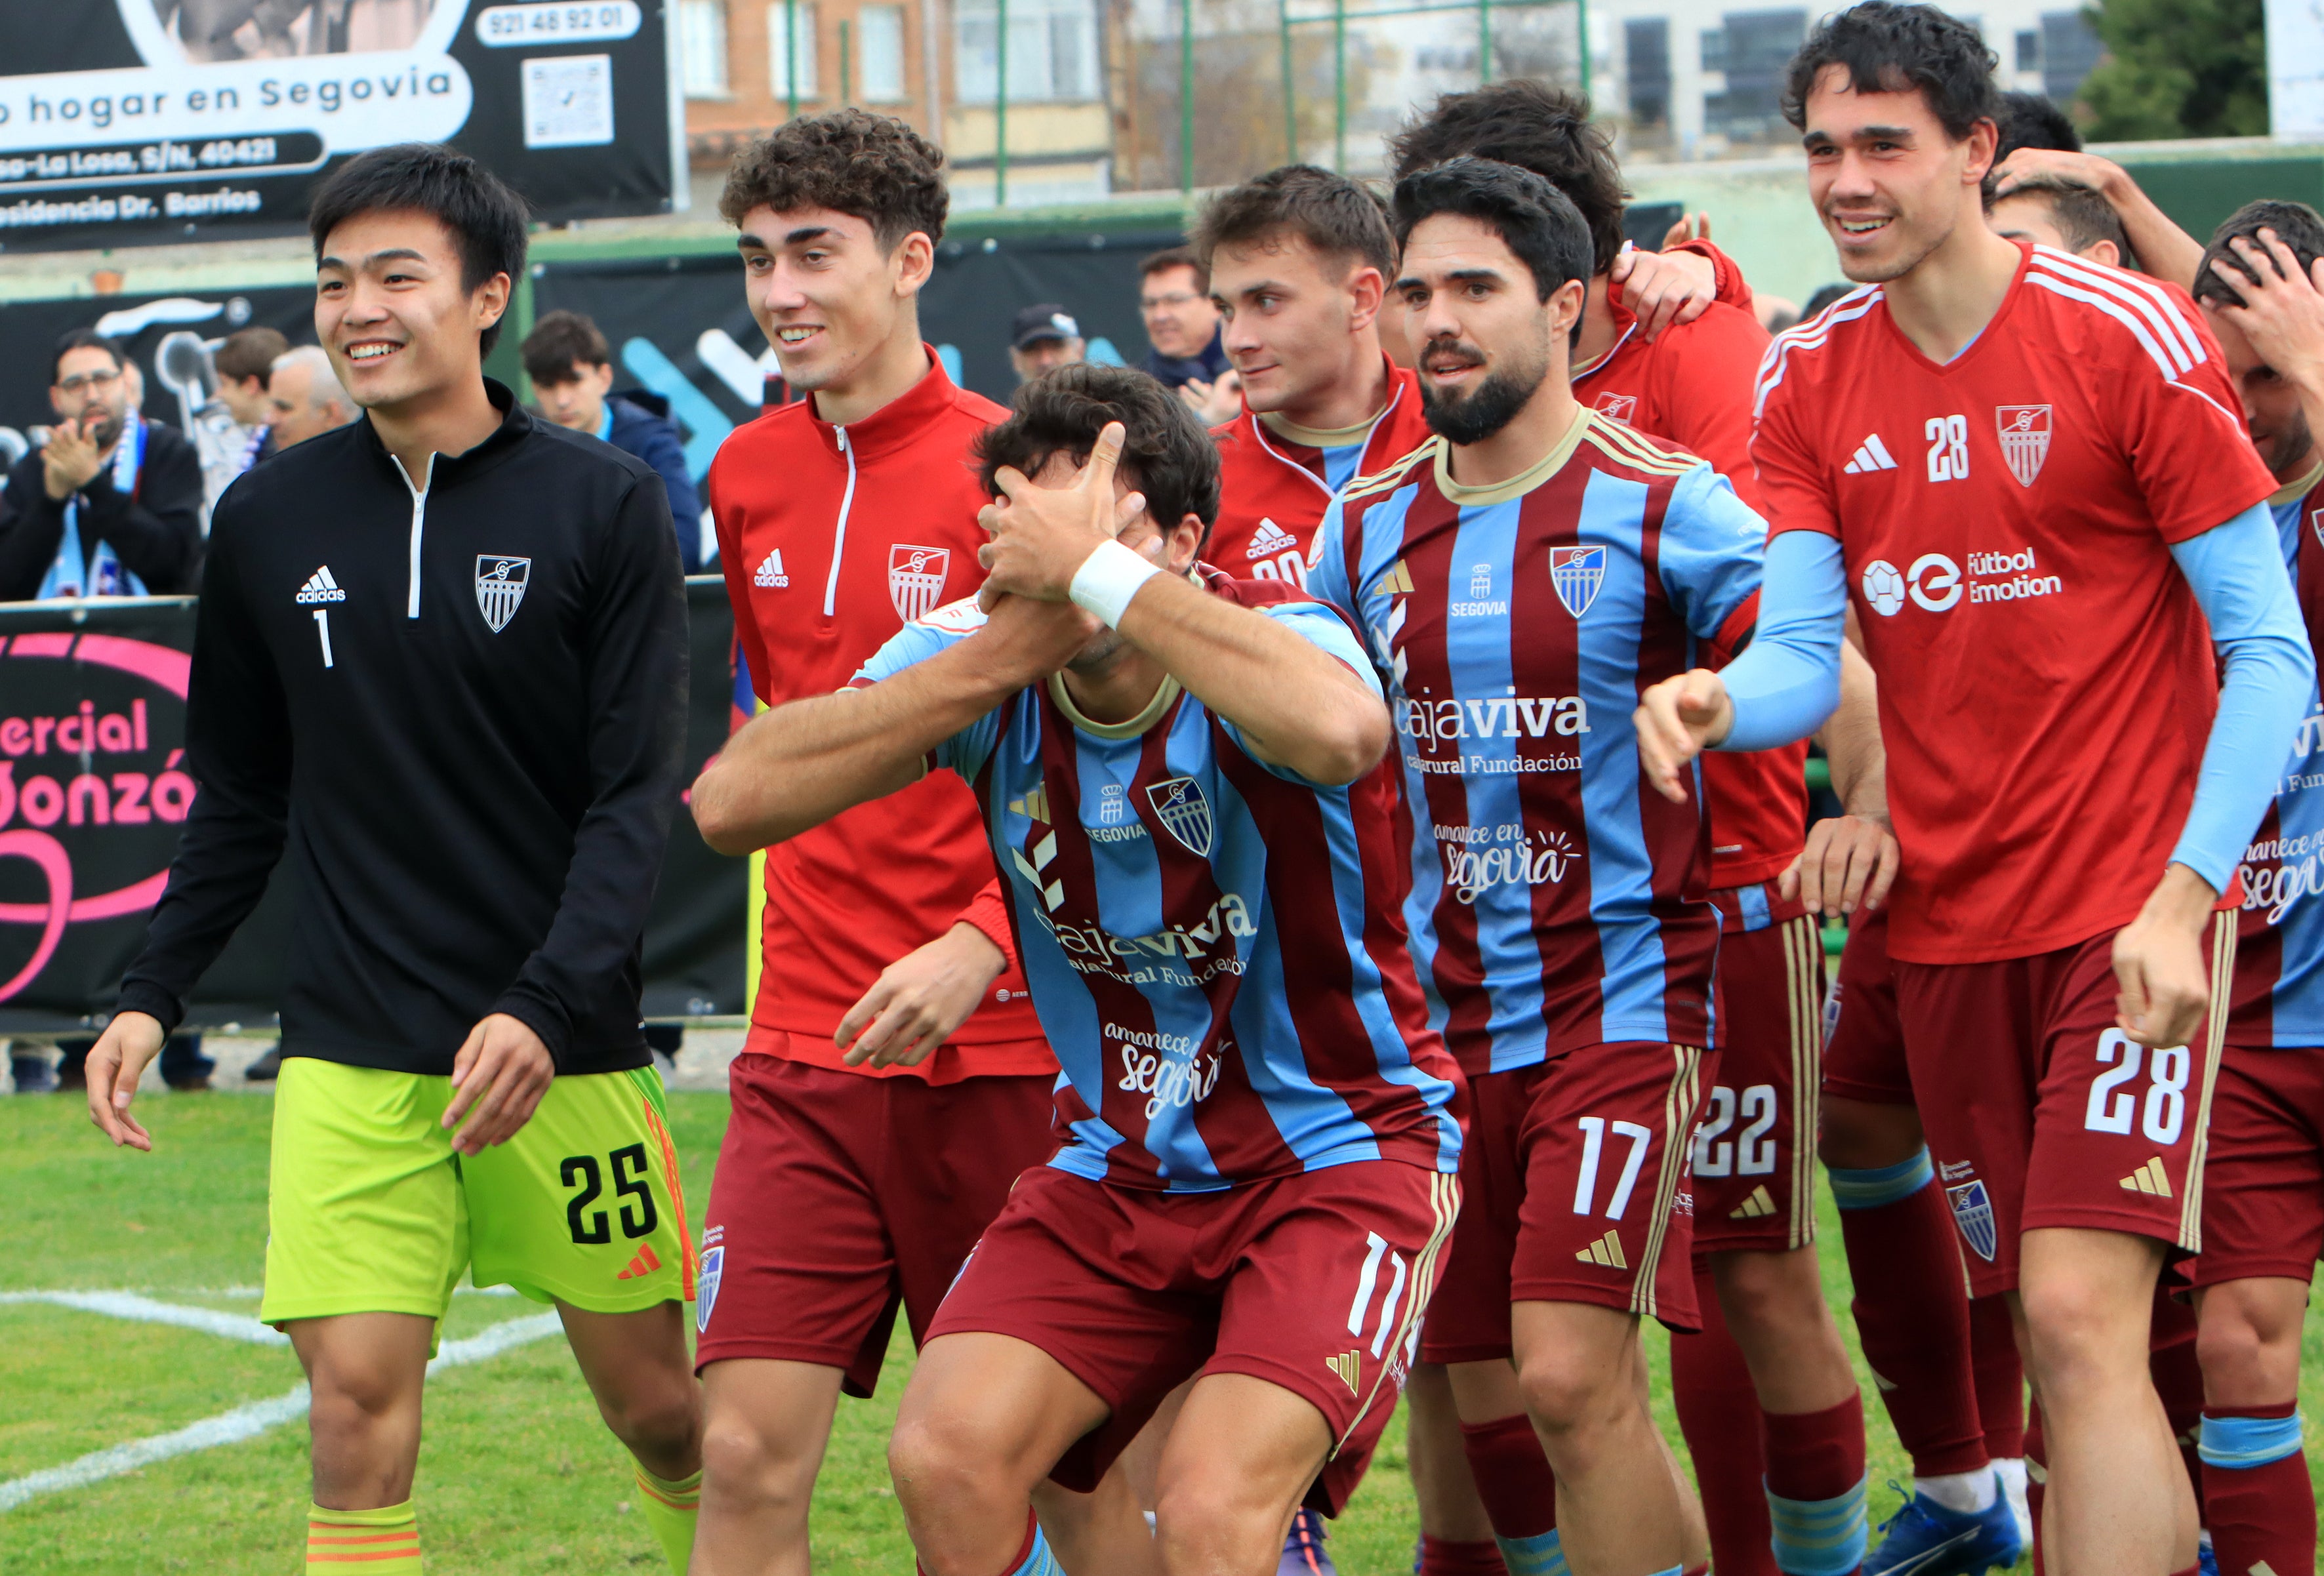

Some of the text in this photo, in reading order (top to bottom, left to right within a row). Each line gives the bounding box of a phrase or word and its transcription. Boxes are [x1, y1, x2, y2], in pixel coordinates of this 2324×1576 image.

[491, 5, 622, 33] 921 48 92 01
[30, 92, 167, 128] hogar
[187, 87, 239, 111] en
[260, 64, 450, 113] Segovia
[70, 151, 138, 174] Losa,
[140, 140, 197, 172] S/N,
[199, 137, 277, 166] 40421
[119, 195, 159, 218] Dr.
[164, 187, 262, 216] Barrios
[1925, 414, 1969, 482] 28
[1246, 535, 1297, 559] adidas
[1968, 547, 2035, 575] Fútbol
[296, 589, 346, 603] adidas
[754, 574, 789, 587] adidas
[1969, 574, 2062, 603] Emotion
[1450, 601, 1507, 617] SEGOVIA
[313, 609, 333, 668] 1
[0, 698, 148, 756] ercial
[1393, 686, 1591, 753] cajaviva
[1470, 752, 1583, 773] Fundación
[1084, 823, 1147, 843] SEGOVIA
[1496, 824, 1524, 841] en
[1104, 1022, 1191, 1056] amanece
[2085, 1027, 2191, 1145] 28
[1693, 1085, 1777, 1177] 22
[1574, 1116, 1651, 1221] 17
[560, 1142, 658, 1244] 25
[1347, 1230, 1406, 1360] 11
